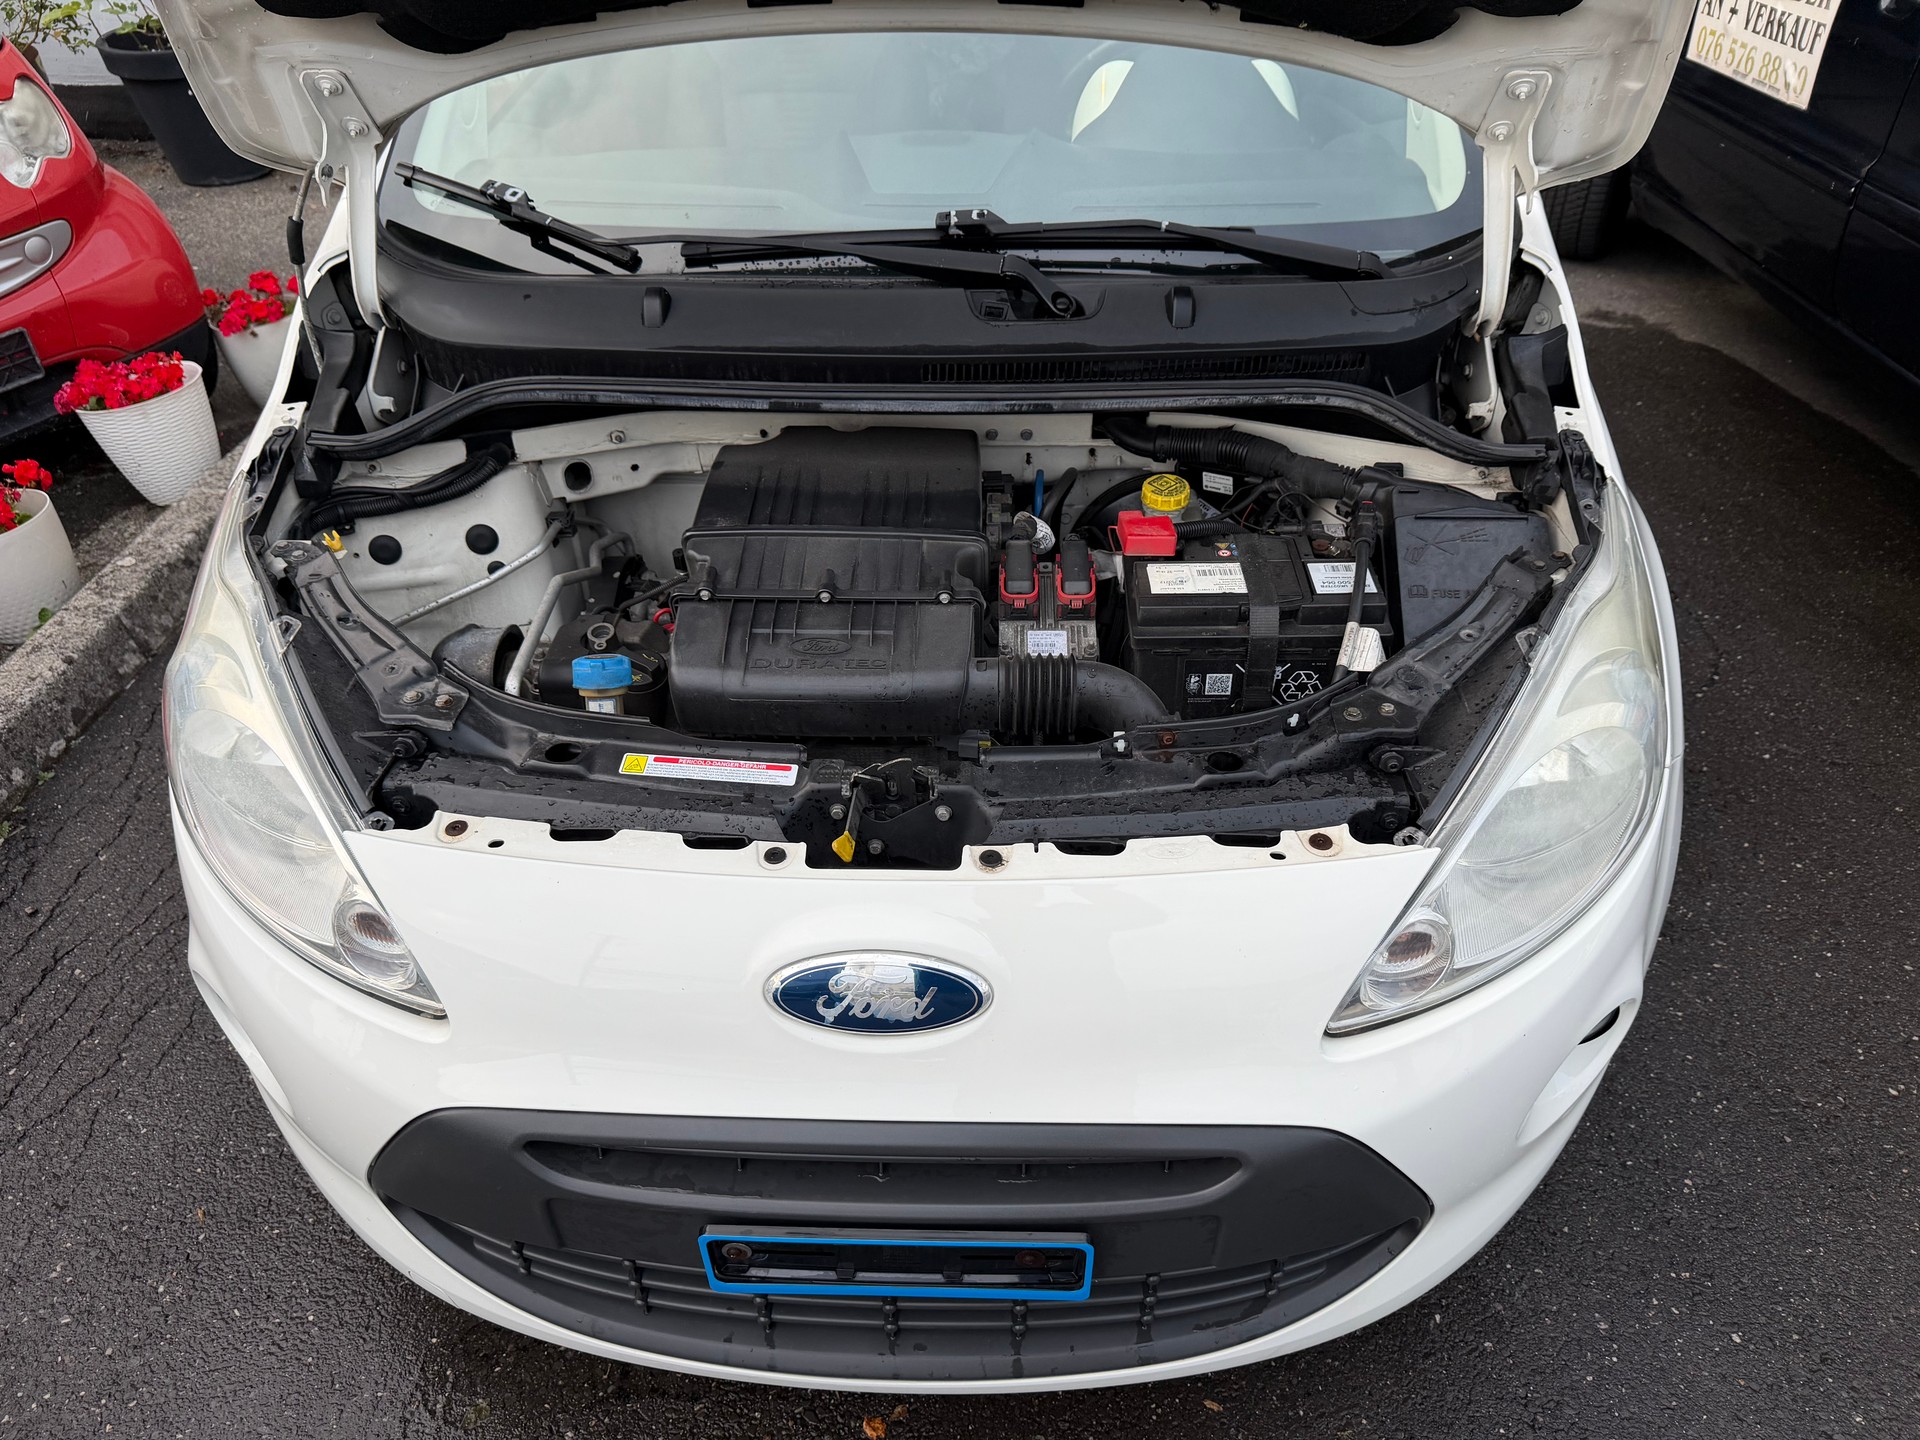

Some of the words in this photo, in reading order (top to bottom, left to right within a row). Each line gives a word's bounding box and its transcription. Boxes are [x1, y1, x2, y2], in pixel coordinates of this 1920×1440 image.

[1744, 1, 1827, 54] VERKAUF
[1696, 25, 1726, 61] 076
[1725, 37, 1758, 75] 576
[1758, 51, 1782, 85] 88
[1431, 589, 1461, 599] FUSE
[802, 640, 841, 653] Ford
[816, 972, 938, 1021] Ford
